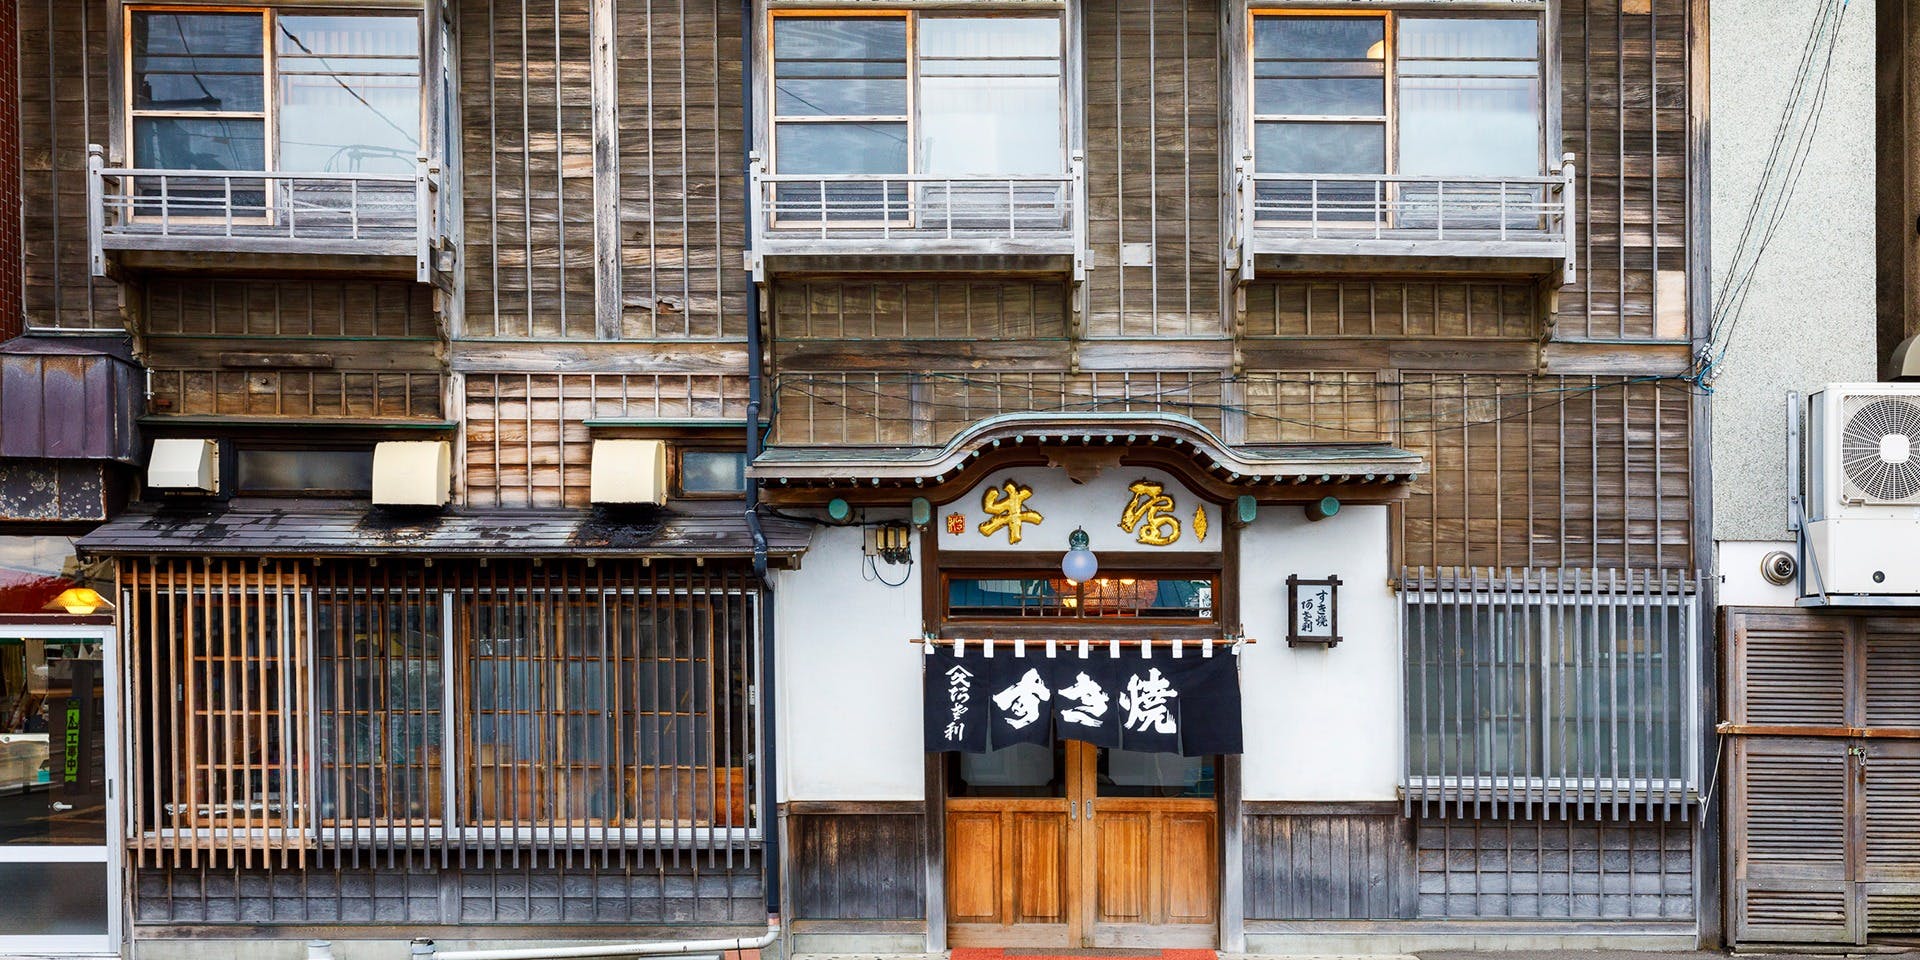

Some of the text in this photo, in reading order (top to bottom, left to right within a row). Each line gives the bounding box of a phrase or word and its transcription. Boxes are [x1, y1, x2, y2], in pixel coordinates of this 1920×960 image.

[1316, 589, 1328, 627] すき焼
[992, 667, 1178, 734] すき焼
[67, 733, 77, 771] 工事中
